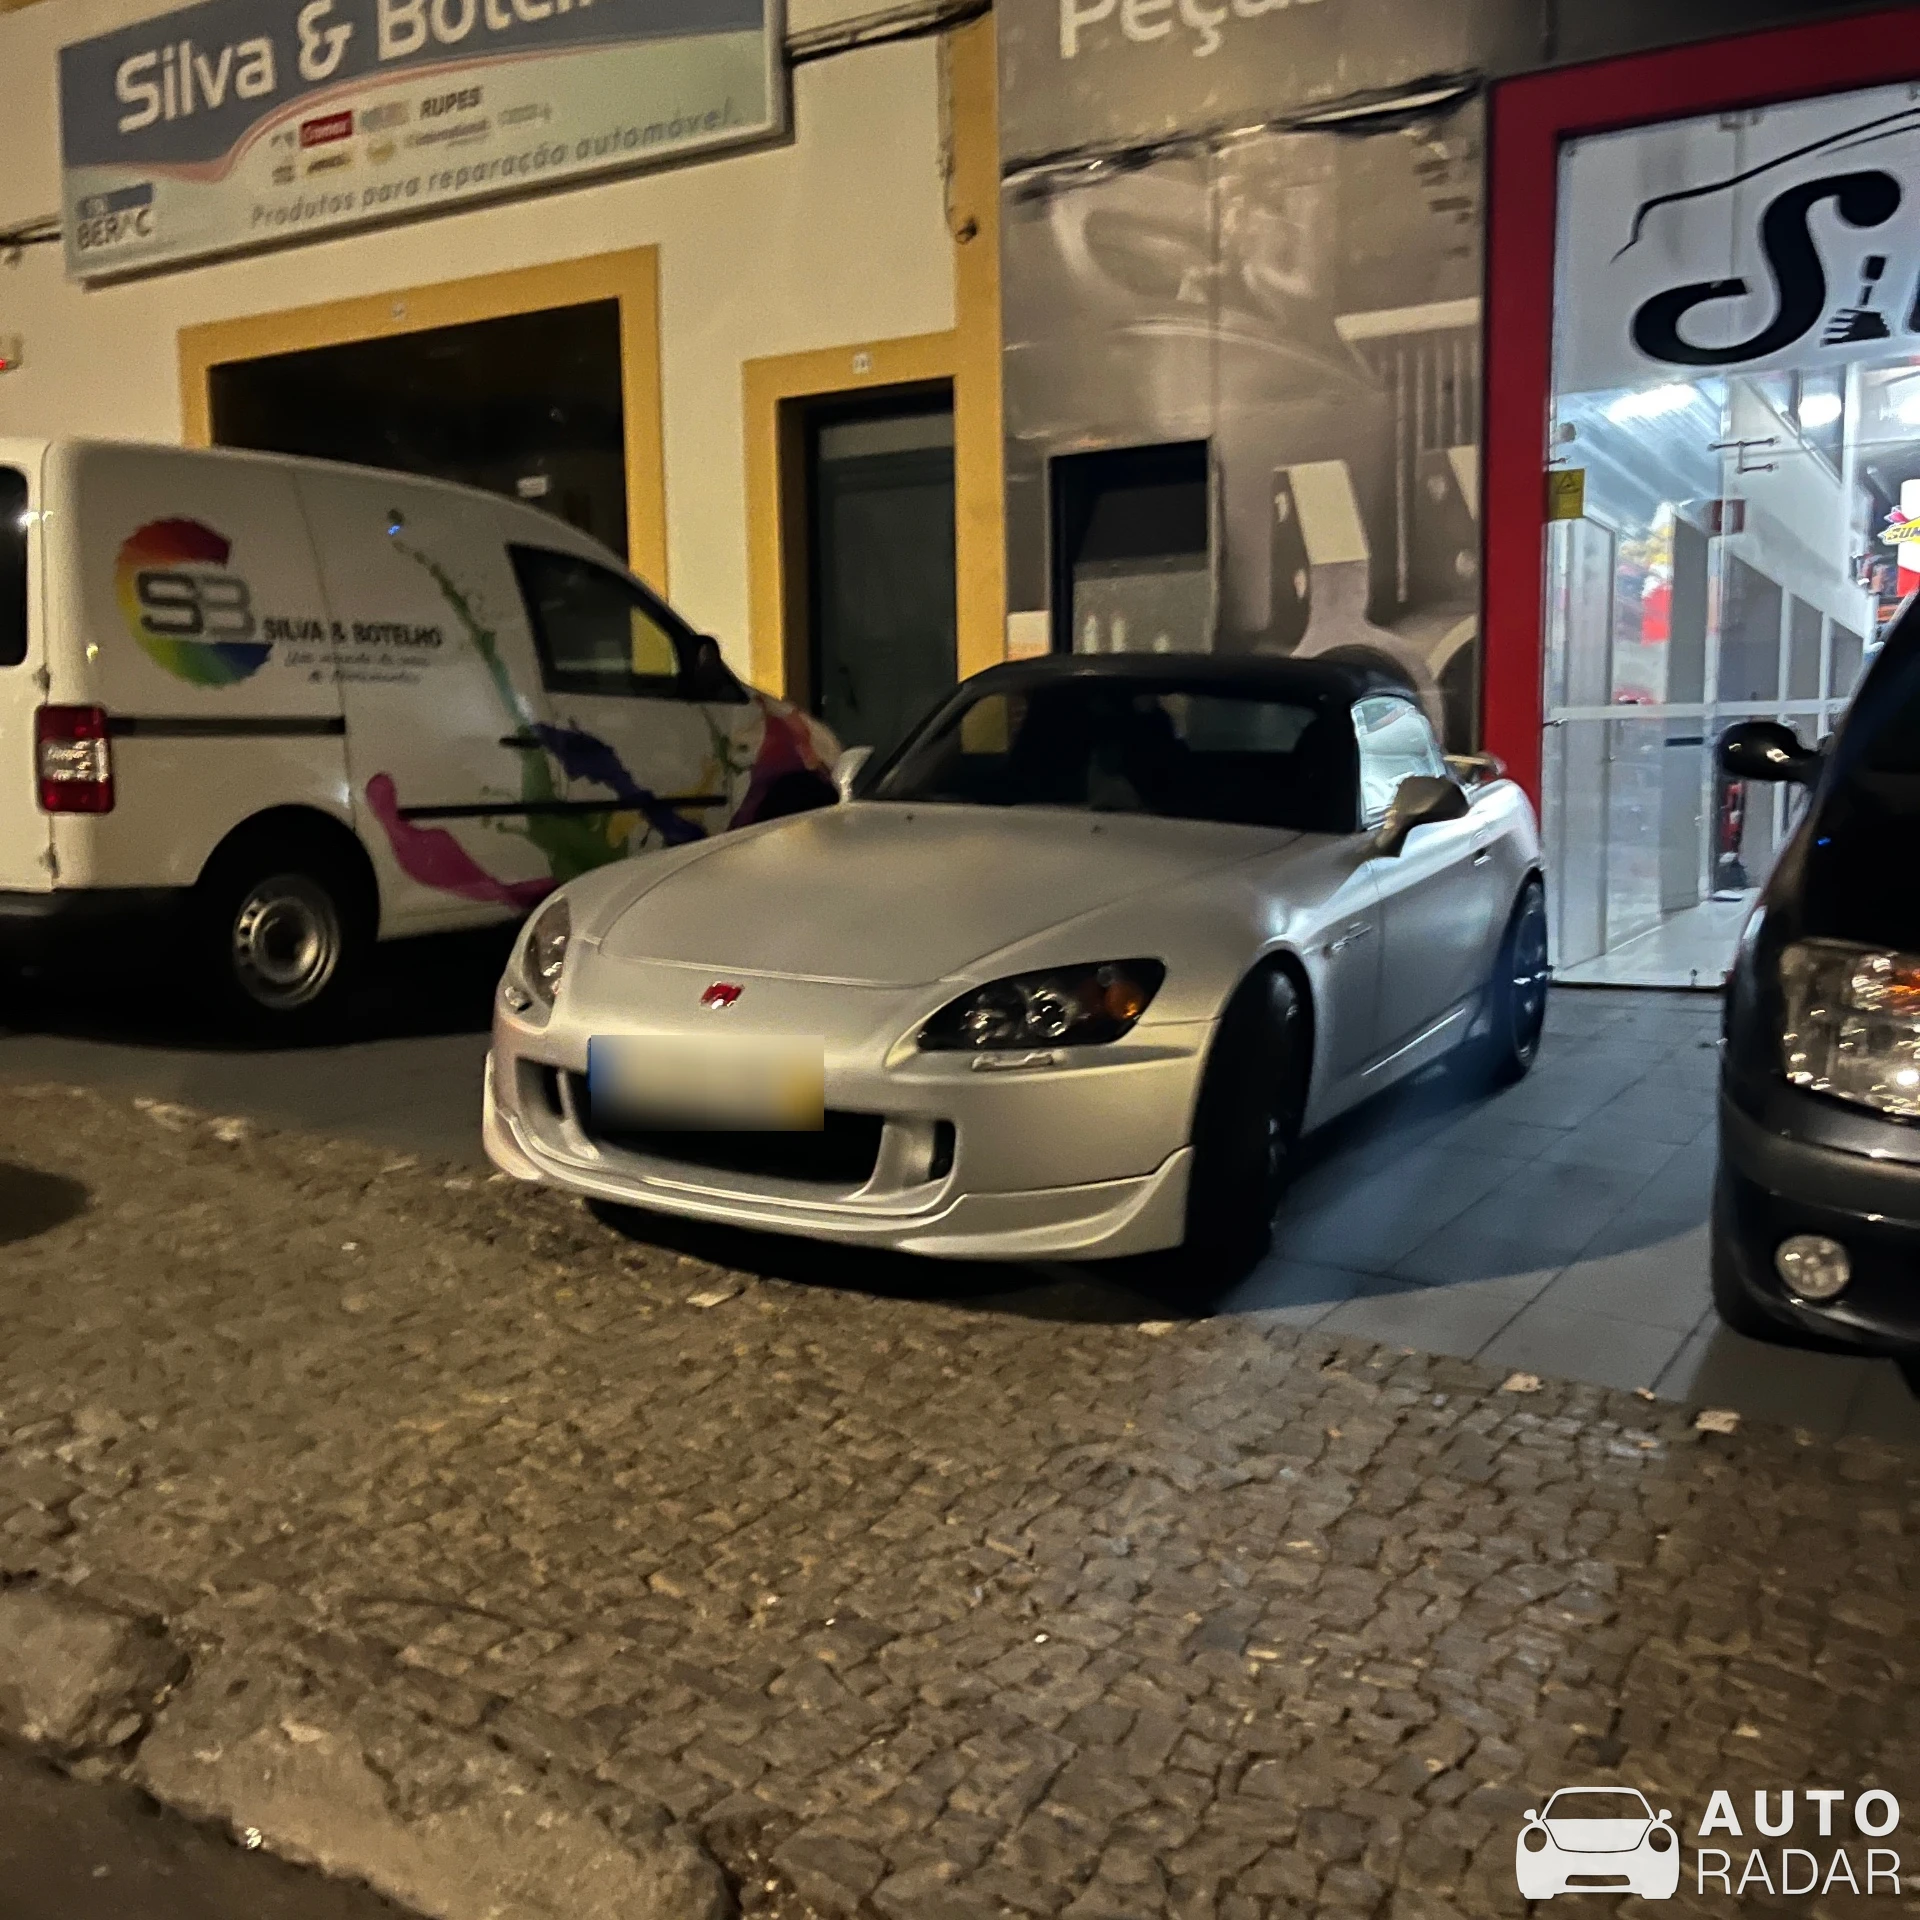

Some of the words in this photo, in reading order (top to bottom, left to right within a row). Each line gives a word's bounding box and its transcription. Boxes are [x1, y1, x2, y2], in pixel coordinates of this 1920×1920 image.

[116, 36, 277, 134] Silva
[297, 0, 354, 81] &
[420, 85, 483, 120] RUPES
[250, 190, 356, 228] Produtos
[360, 175, 422, 211] para
[426, 142, 569, 192] reparação
[263, 617, 325, 645] SILVA
[330, 619, 348, 646] &
[351, 620, 444, 650] BOTELHO
